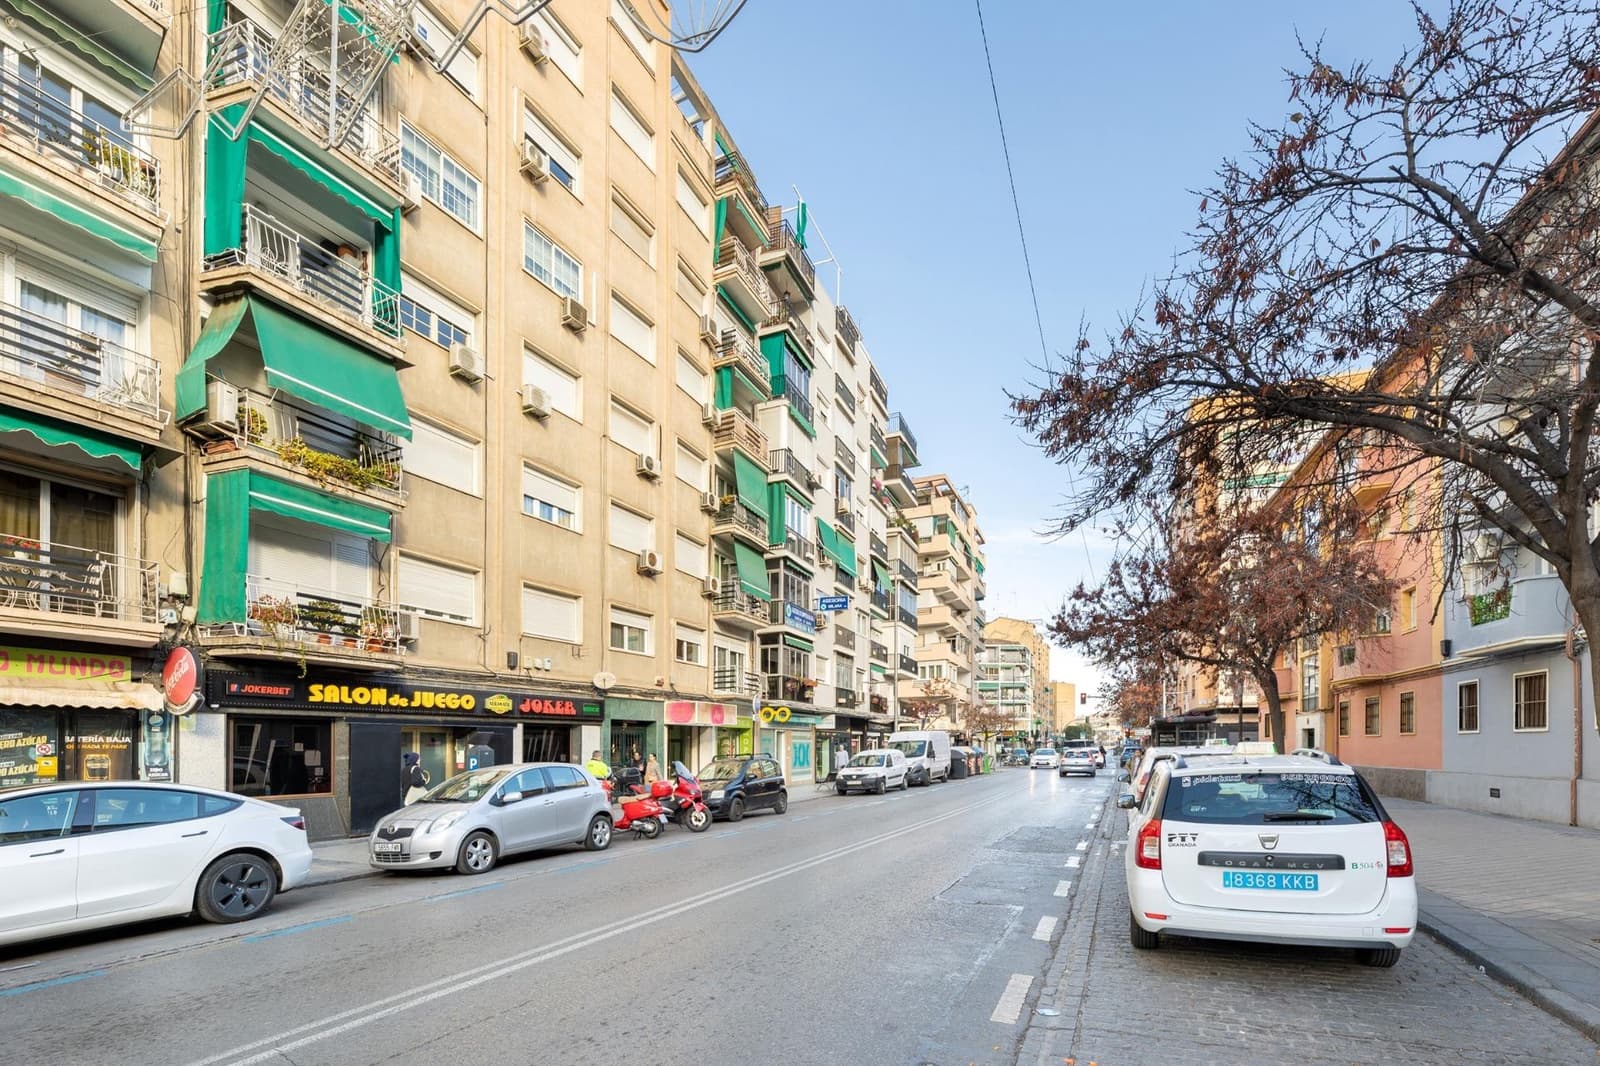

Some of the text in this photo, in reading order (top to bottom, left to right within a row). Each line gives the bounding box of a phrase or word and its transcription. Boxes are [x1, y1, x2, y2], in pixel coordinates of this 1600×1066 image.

[25, 653, 125, 679] MUNDO
[241, 684, 291, 695] JOKERBET
[308, 684, 475, 710] SALON de JUEGO
[519, 698, 576, 715] JOKER
[470, 758, 478, 769] P
[1211, 860, 1275, 868] LOGAN
[1234, 874, 1315, 889] 8368 KKB
